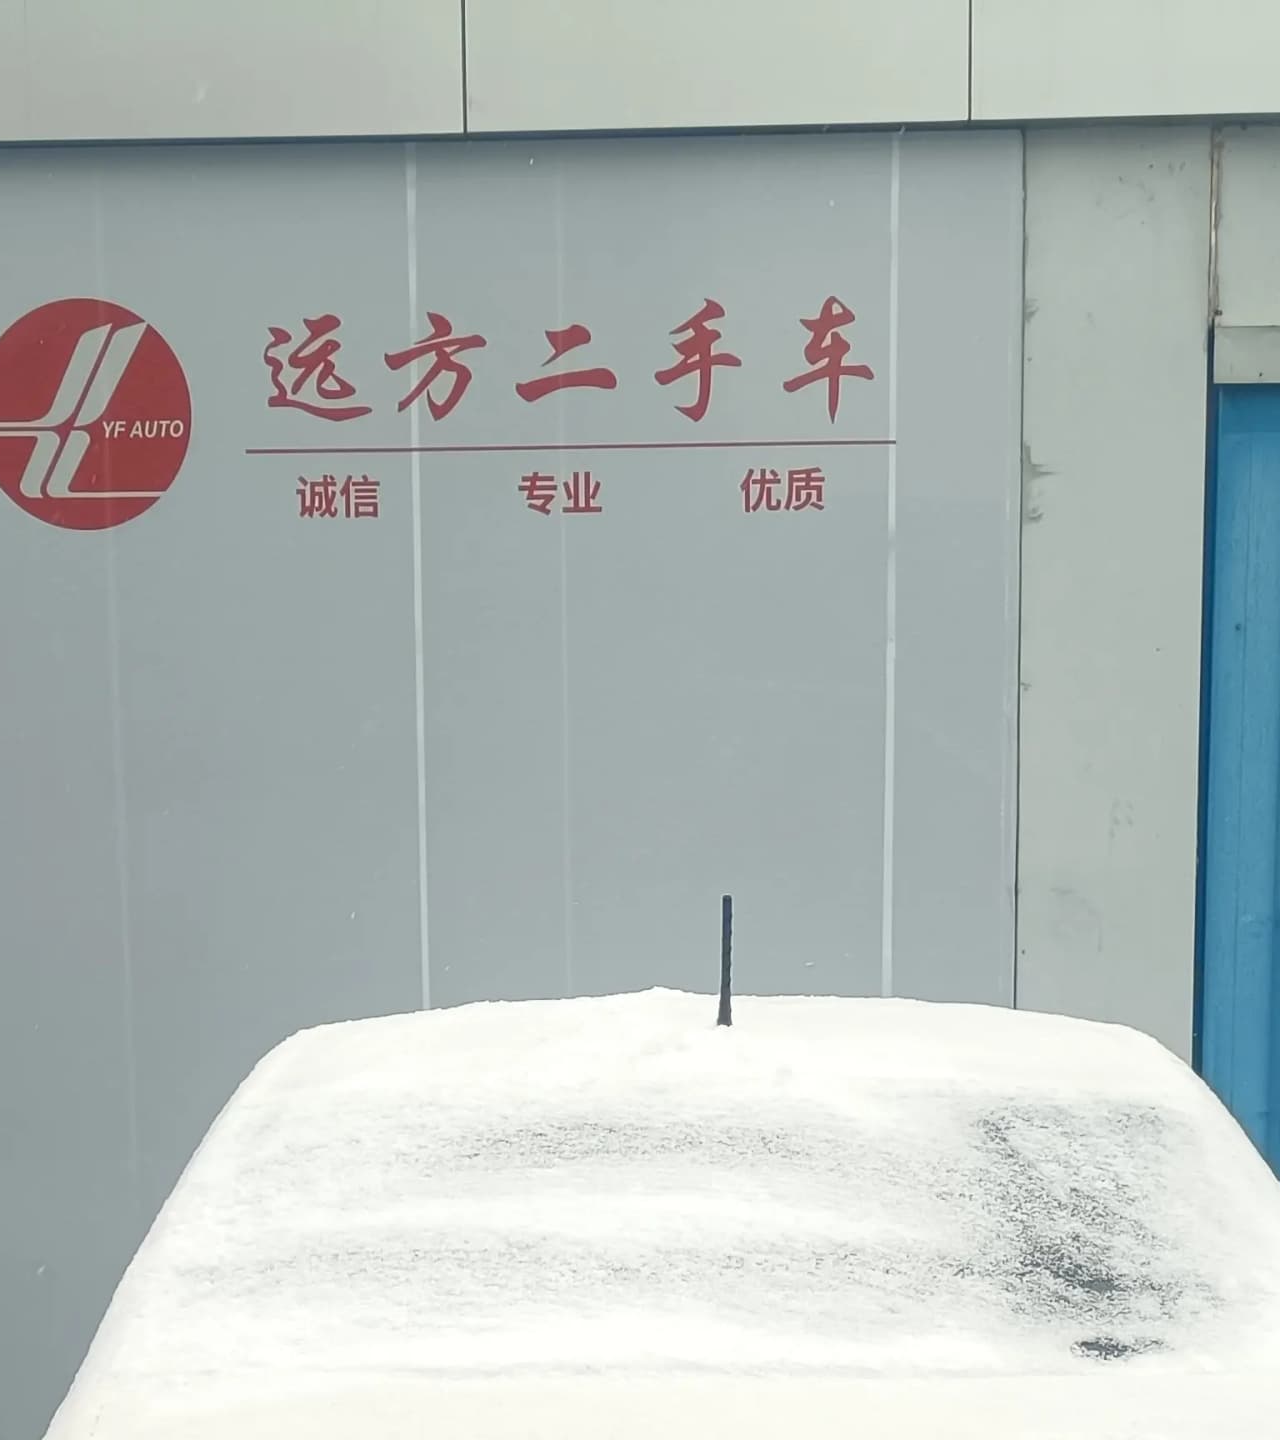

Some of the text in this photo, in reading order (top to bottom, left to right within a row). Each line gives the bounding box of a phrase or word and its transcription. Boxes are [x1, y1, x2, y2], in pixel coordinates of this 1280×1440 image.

[263, 297, 876, 424] 远方二手车
[102, 420, 184, 438] YF AUTO
[296, 467, 827, 519] 诚信 专业 优质
